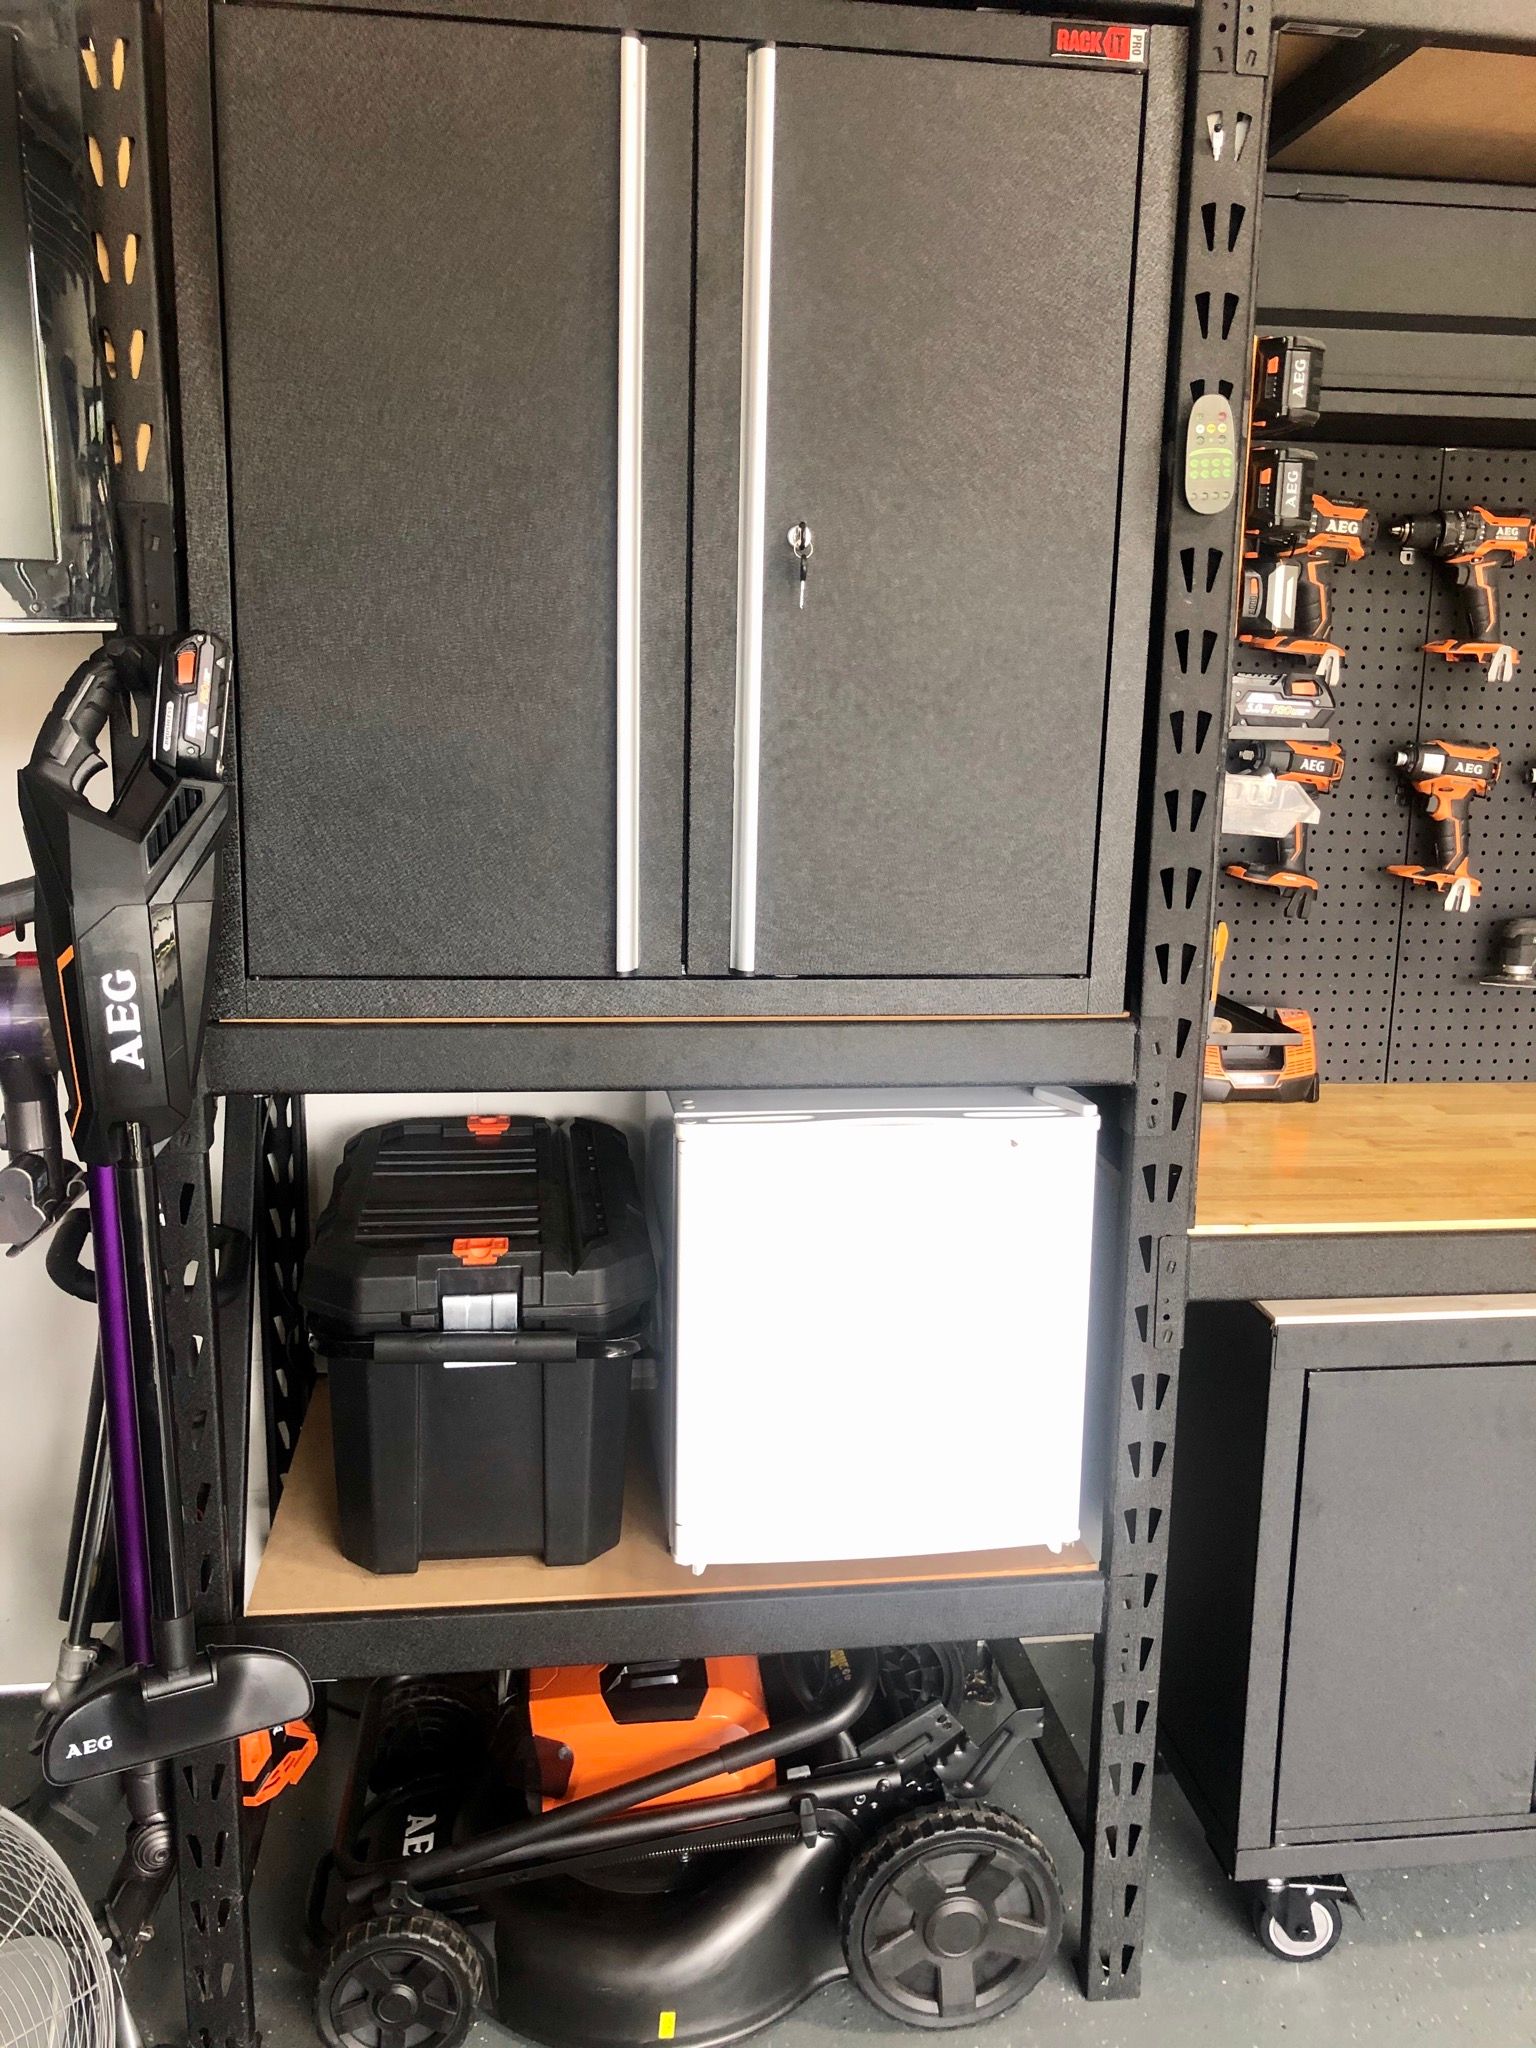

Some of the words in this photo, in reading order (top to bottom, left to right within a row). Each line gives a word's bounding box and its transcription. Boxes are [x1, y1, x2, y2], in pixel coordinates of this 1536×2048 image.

[1056, 28, 1103, 53] RACK
[1132, 35, 1142, 56] PRO
[1292, 358, 1307, 399] AEG
[1285, 469, 1299, 508] AEG
[1326, 519, 1359, 534] AEG
[1495, 526, 1519, 536] AEG
[1300, 758, 1326, 773] AEG
[1454, 761, 1483, 774] AEG
[102, 968, 145, 1070] AEG
[65, 1735, 113, 1759] AEG
[402, 1814, 437, 1857] AE
